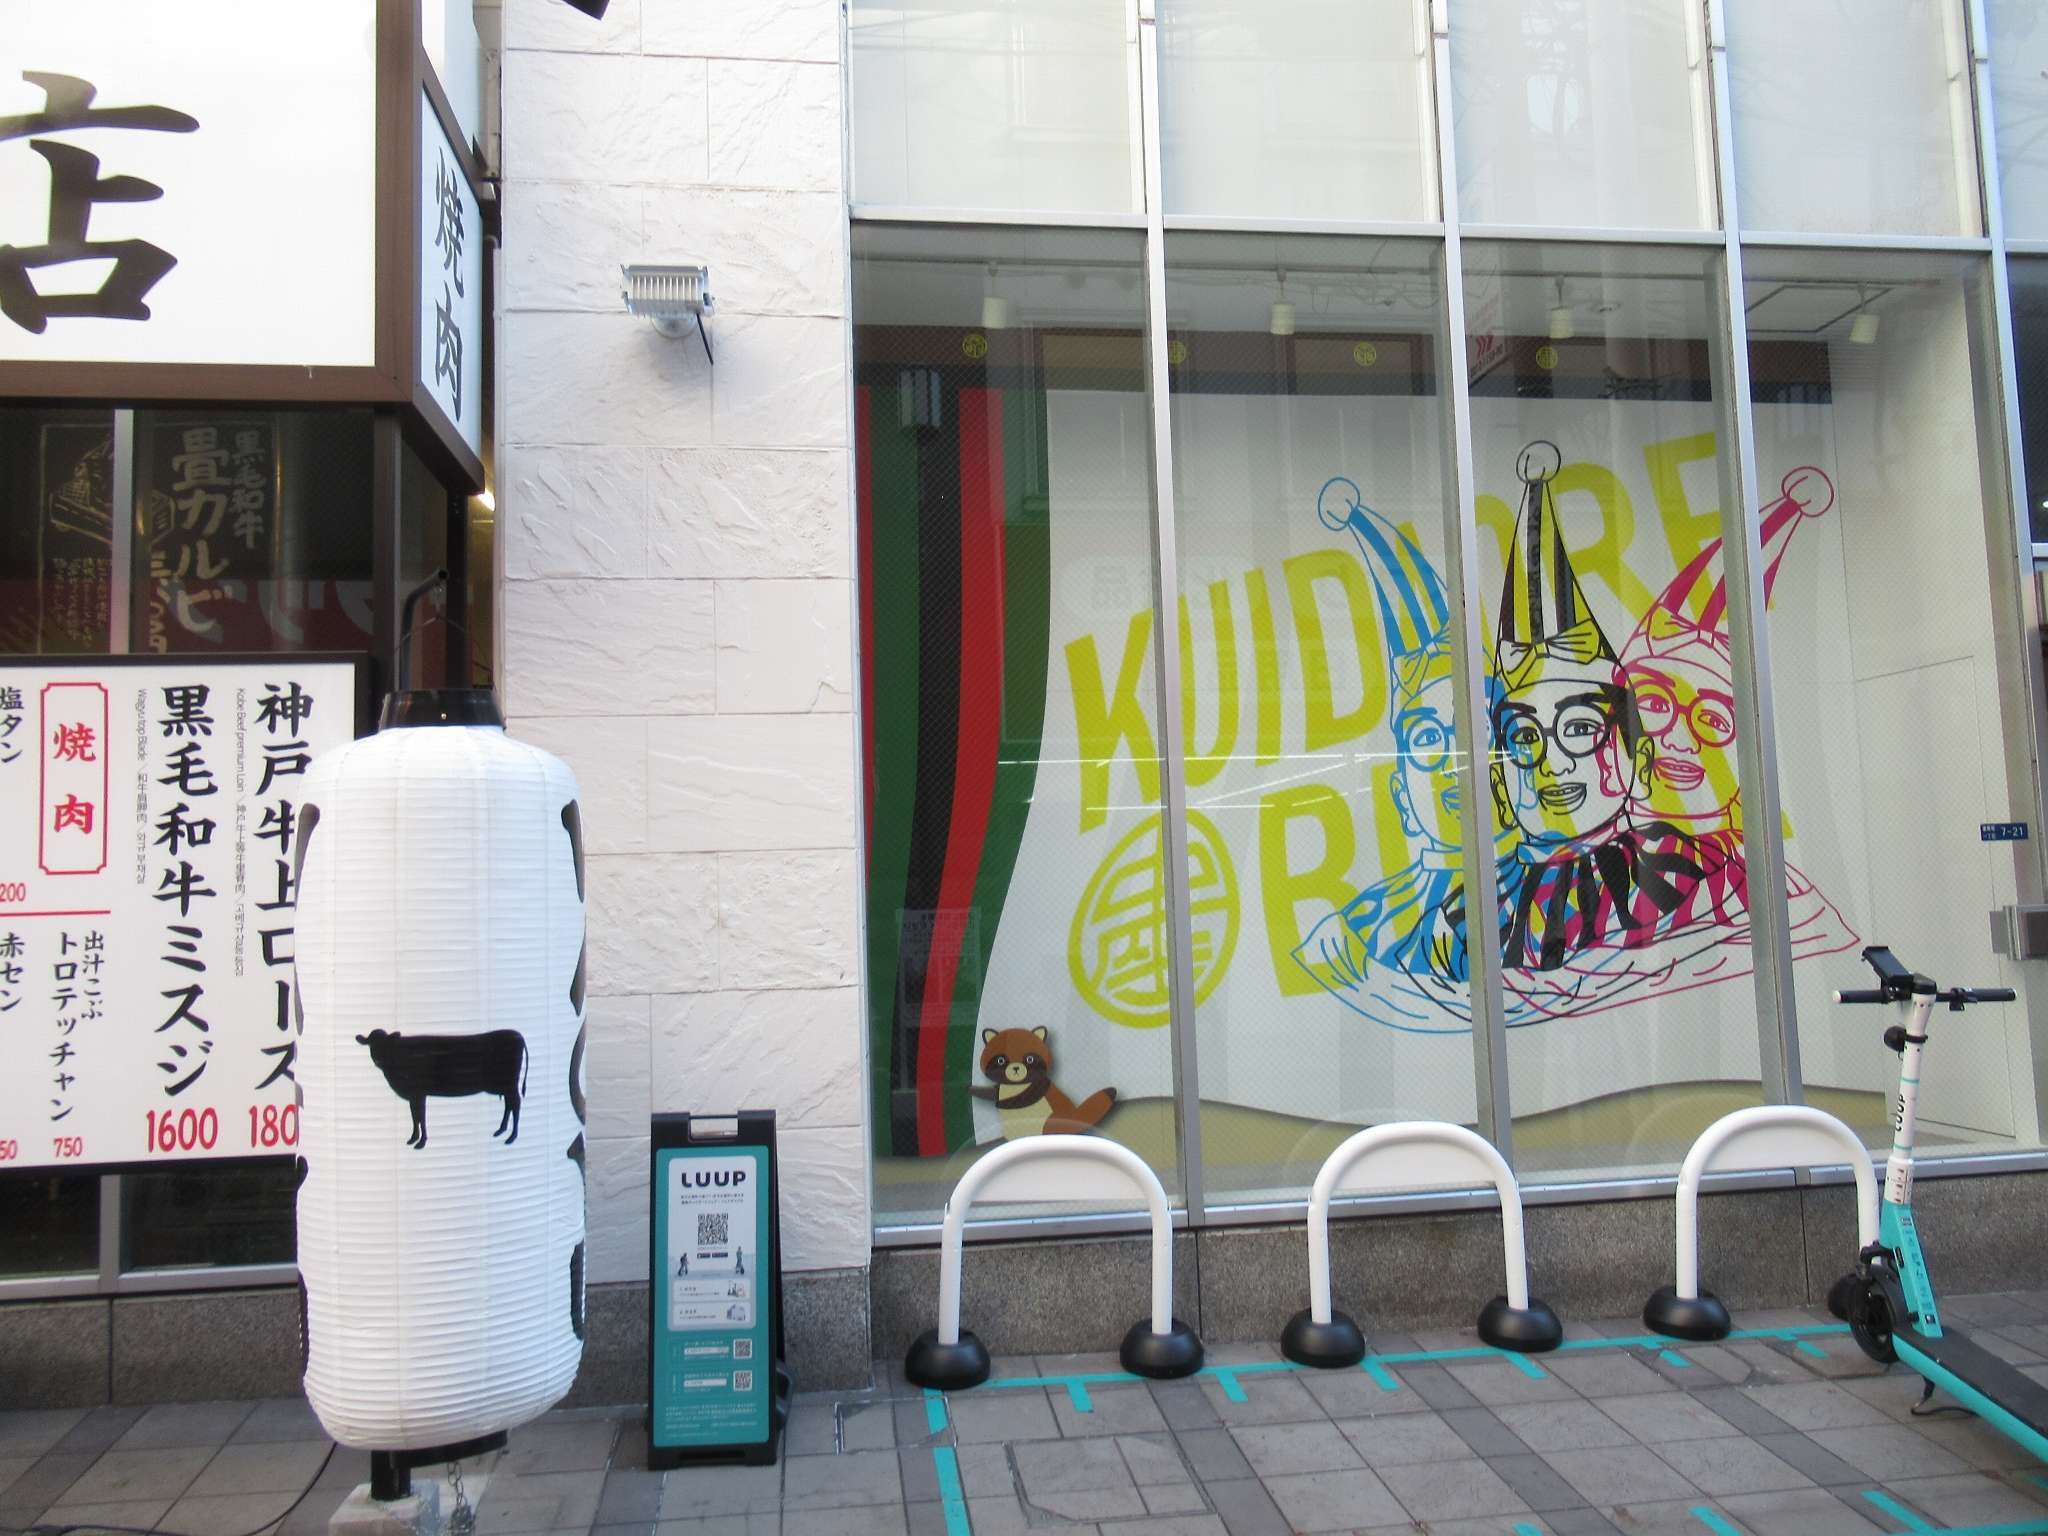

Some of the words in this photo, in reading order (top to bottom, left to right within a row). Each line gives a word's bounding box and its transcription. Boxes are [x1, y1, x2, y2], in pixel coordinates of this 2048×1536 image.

[0, 71, 200, 335] 店
[435, 146, 465, 423] 焼肉
[0, 687, 24, 764] 塩タン
[53, 722, 96, 834] 焼肉
[153, 684, 218, 1097] 黒毛和牛ミスジ
[82, 930, 104, 1019] 出汁こぶ
[50, 932, 78, 1121] トロテッチャン
[53, 1137, 83, 1157] 750
[146, 1107, 218, 1152] 1600
[682, 1171, 746, 1188] LUUP
